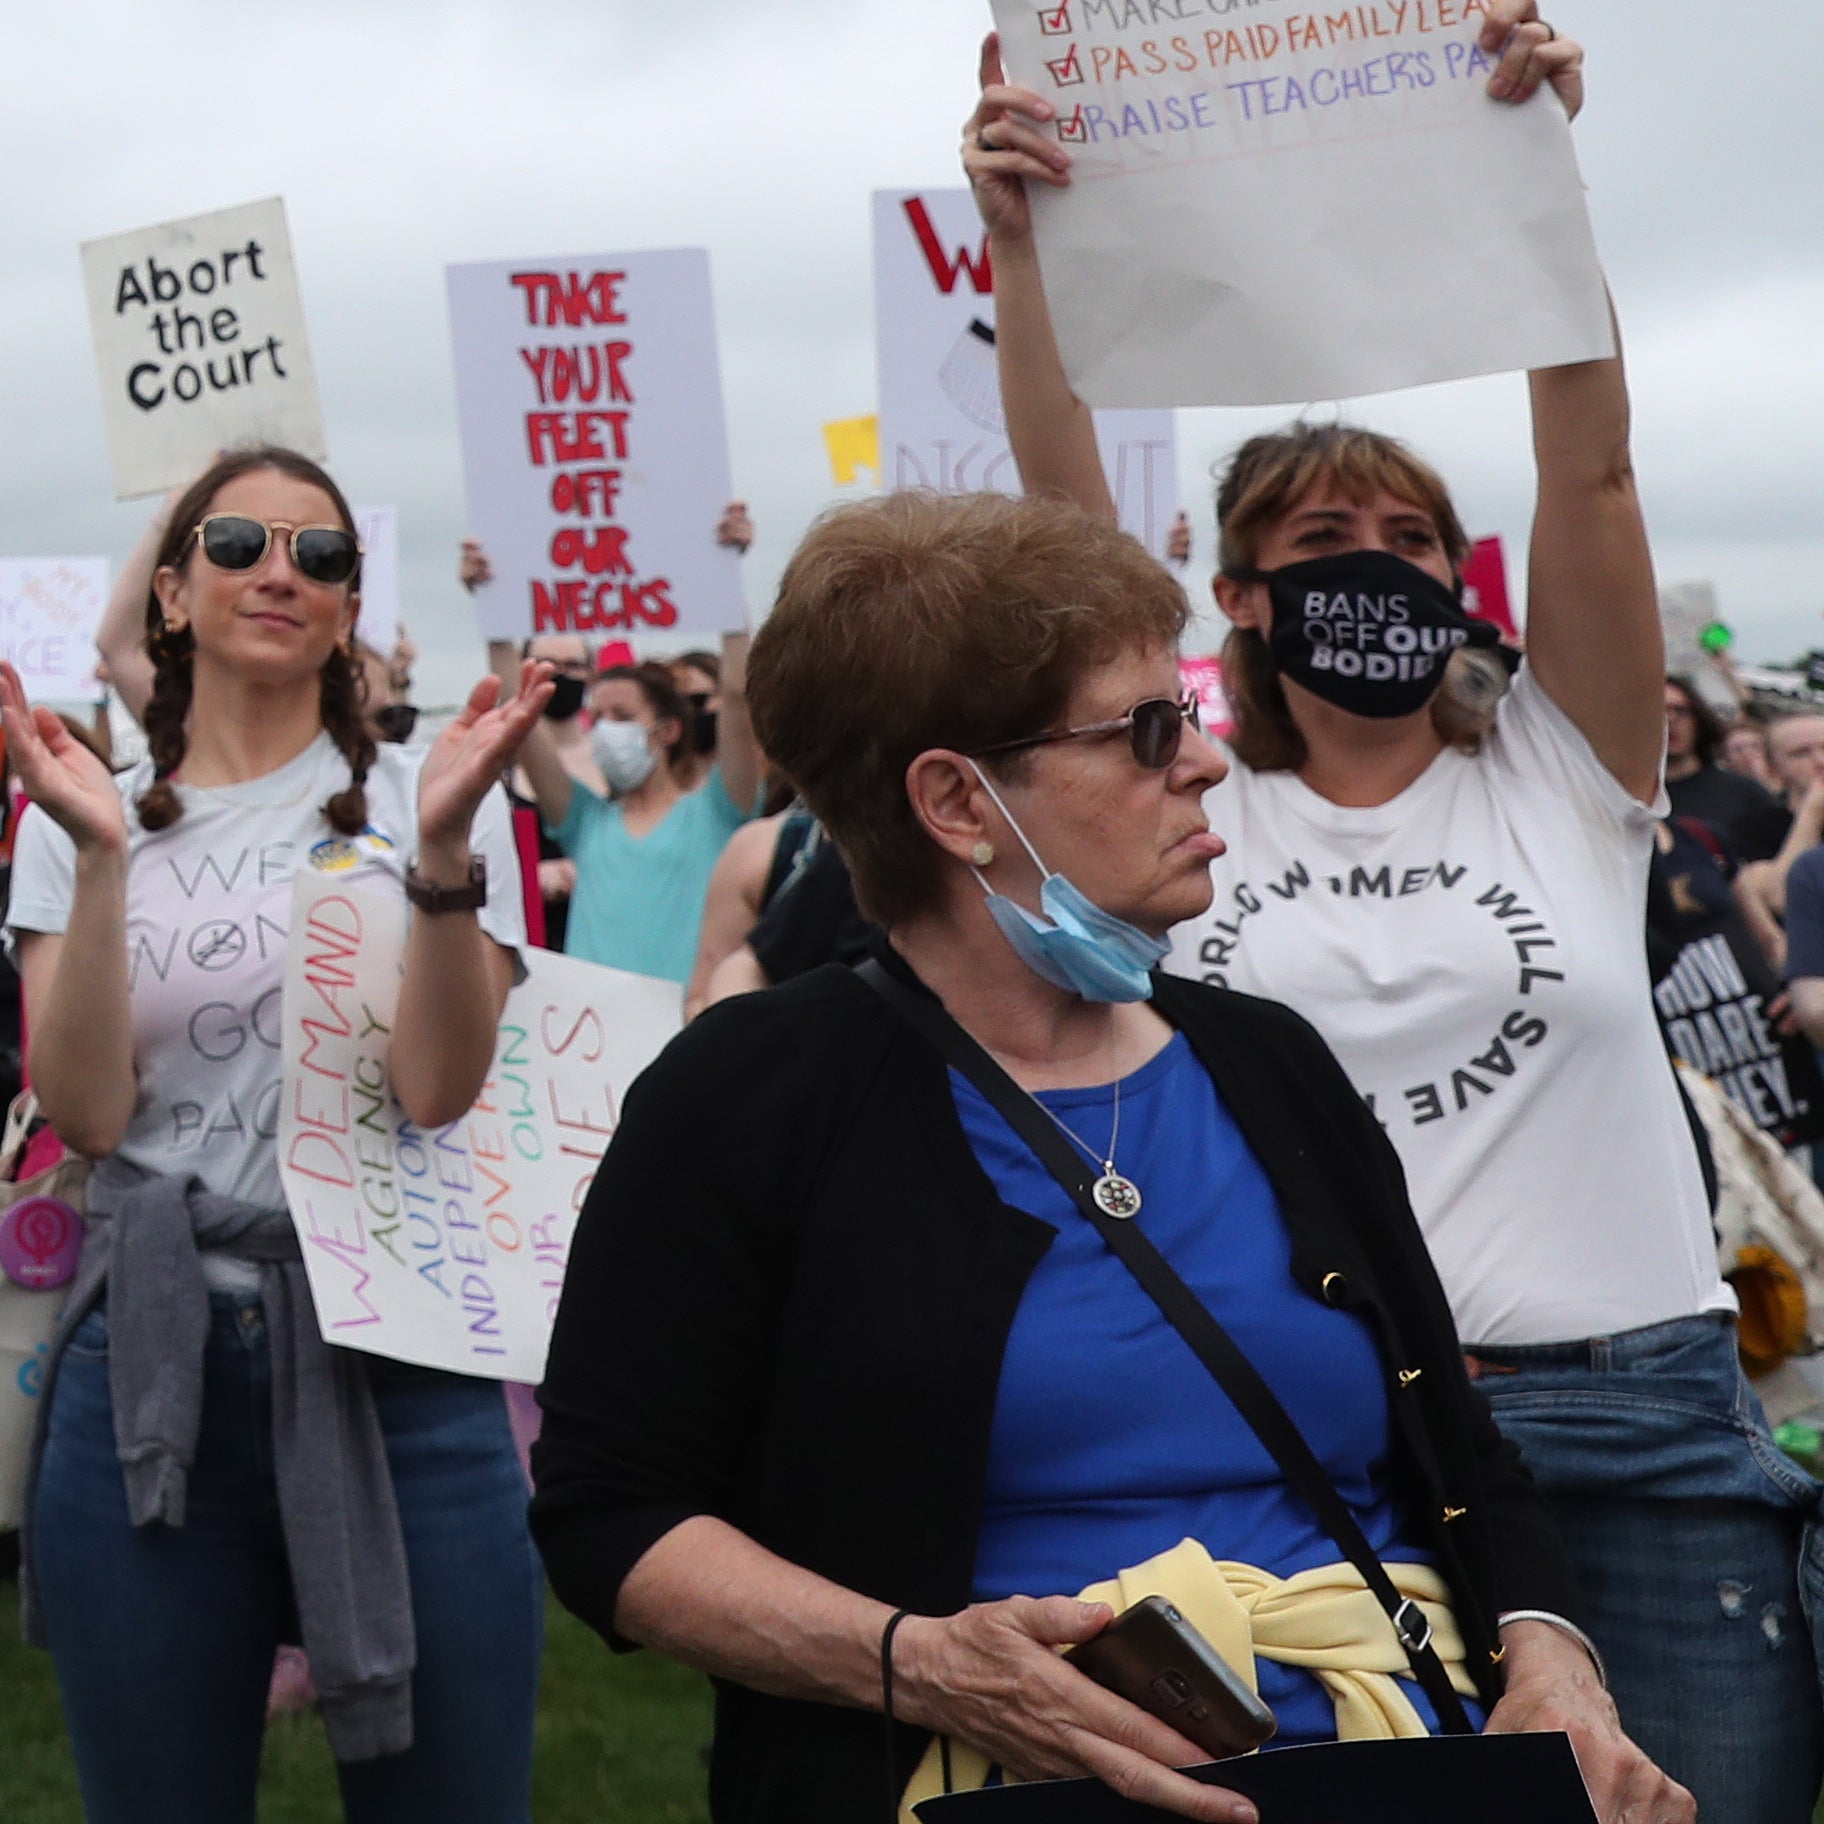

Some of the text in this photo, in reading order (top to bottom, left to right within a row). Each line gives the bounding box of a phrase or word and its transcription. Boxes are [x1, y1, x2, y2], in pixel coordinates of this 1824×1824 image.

[1089, 34, 1201, 85] PASS
[1204, 18, 1280, 69] PAID
[1082, 91, 1216, 144] RAISE
[1442, 39, 1496, 80] PA
[115, 239, 266, 314] Abort
[511, 272, 627, 327] TAKE
[150, 306, 240, 354] the
[127, 335, 287, 410] Court
[520, 340, 633, 405] YOUR
[526, 410, 630, 466] FEET
[552, 470, 624, 517] OFF
[551, 526, 634, 576] OUR
[530, 578, 678, 633] NECKS
[1302, 618, 1379, 651] OFF
[1303, 590, 1410, 624] BANS
[1475, 883, 1565, 995] WILL
[287, 894, 364, 1190] DEMAND
[1403, 1009, 1548, 1126] SAVE
[498, 1022, 545, 1163] OWN
[351, 1002, 408, 1267] AGENCY
[305, 1197, 383, 1330] WE
